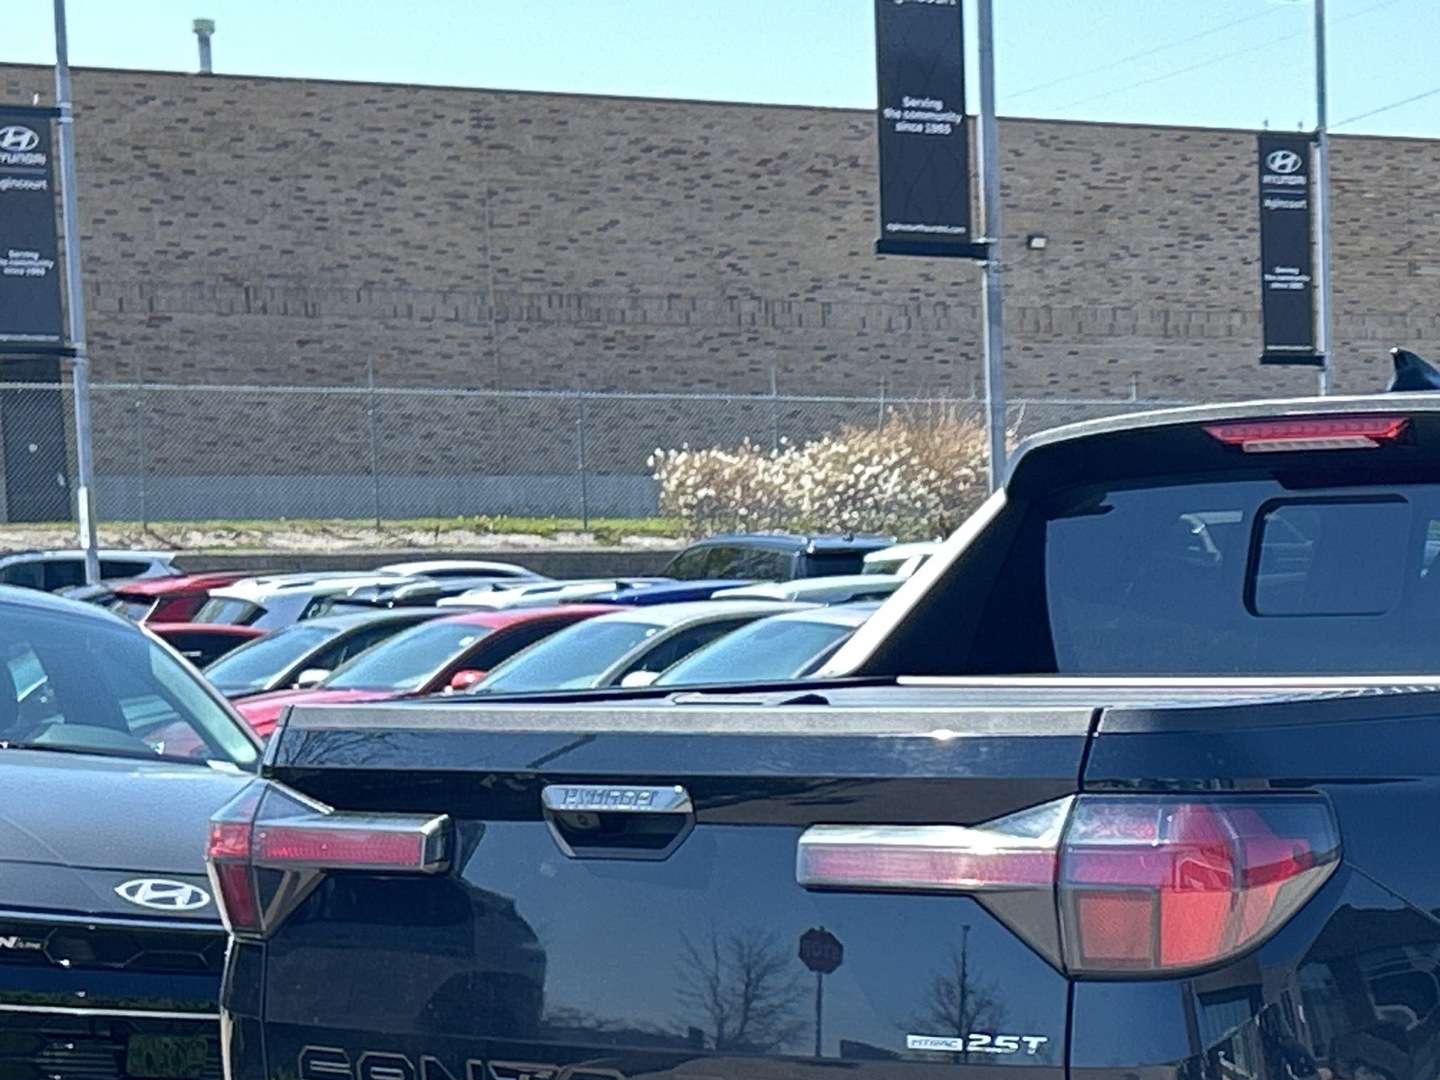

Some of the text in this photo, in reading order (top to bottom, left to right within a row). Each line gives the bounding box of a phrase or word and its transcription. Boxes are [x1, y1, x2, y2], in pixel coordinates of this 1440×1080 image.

[902, 95, 943, 111] Serving
[883, 107, 963, 124] the community
[895, 121, 923, 132] since
